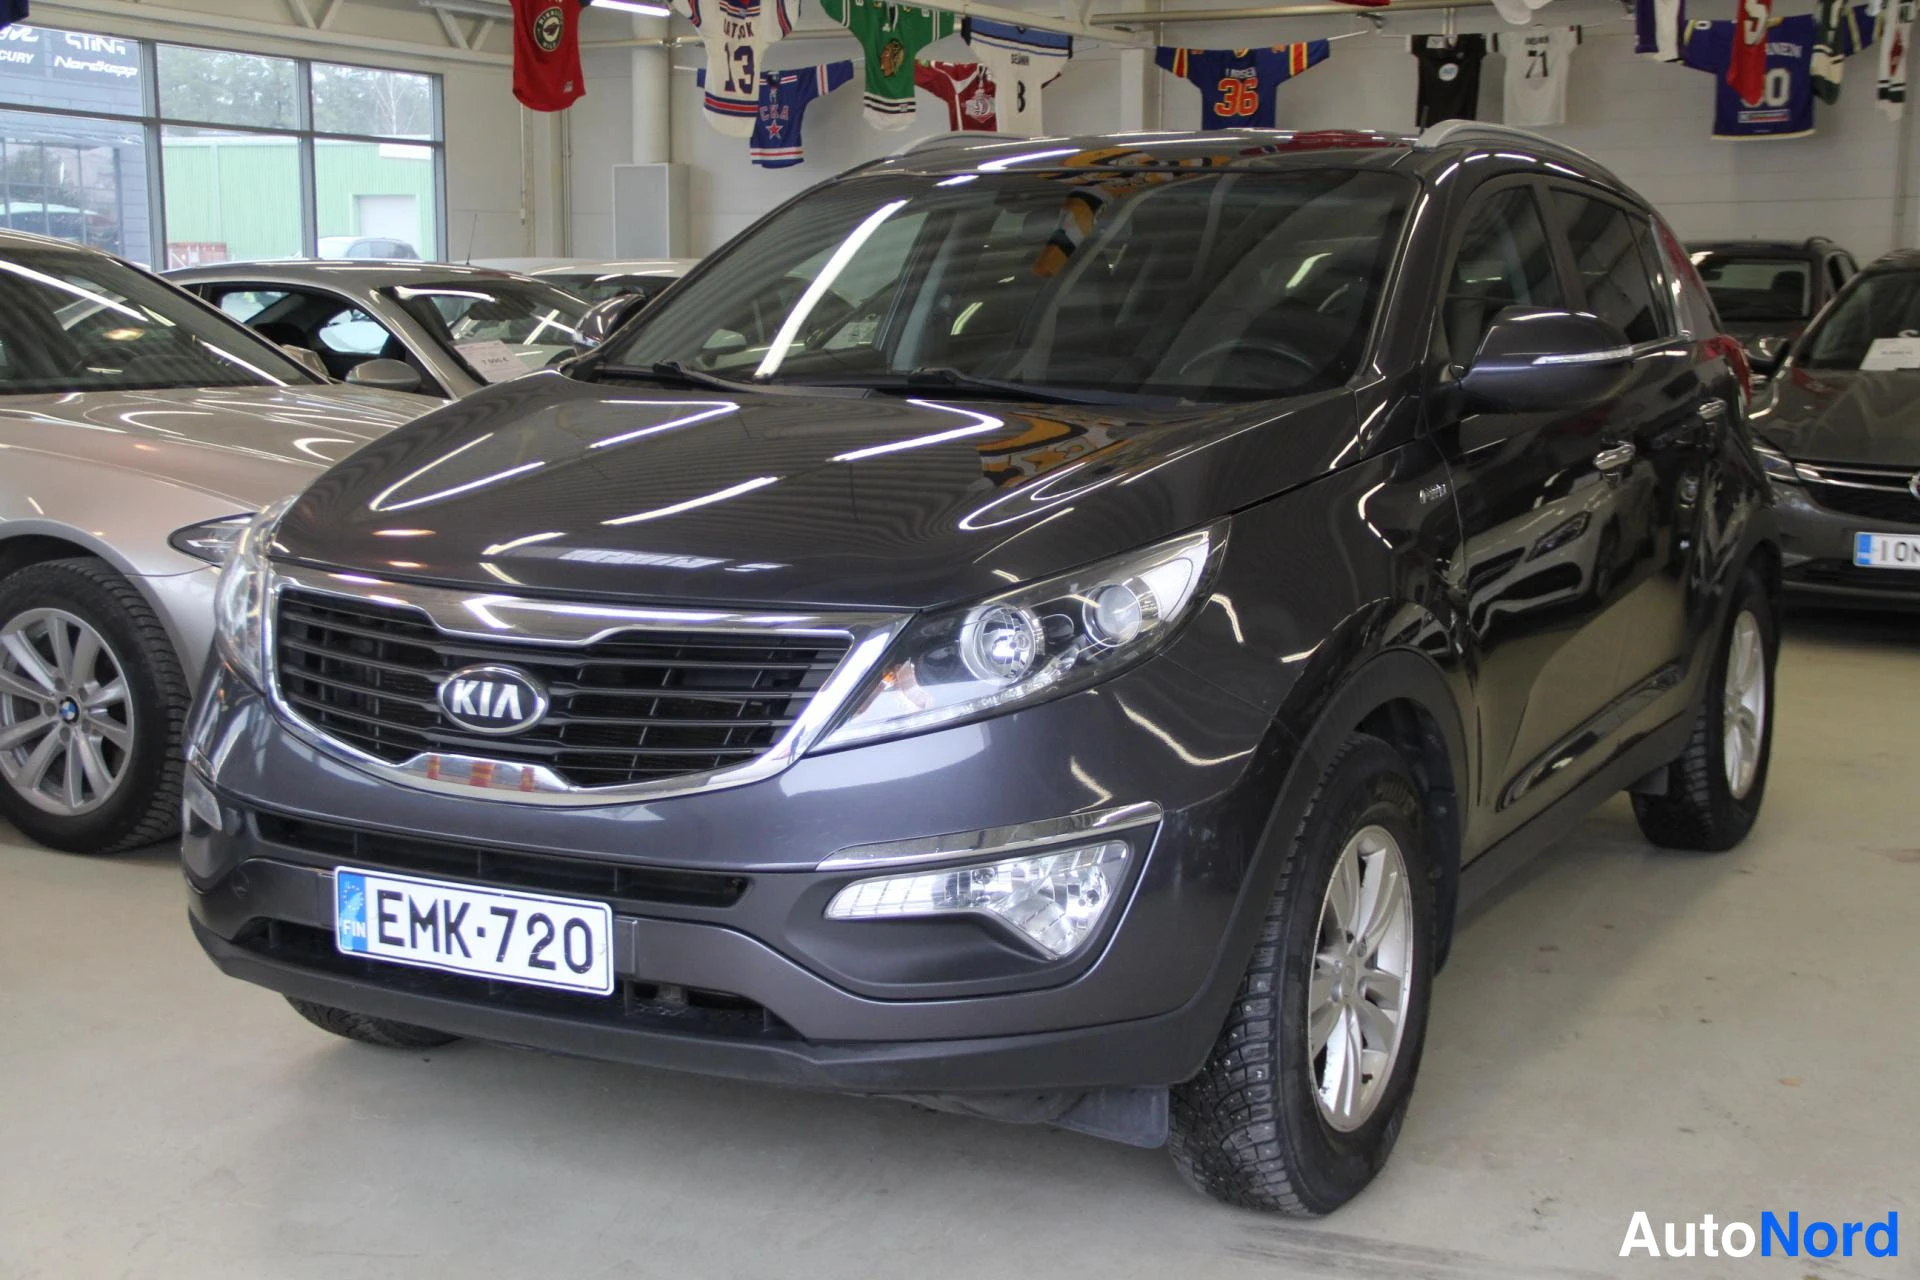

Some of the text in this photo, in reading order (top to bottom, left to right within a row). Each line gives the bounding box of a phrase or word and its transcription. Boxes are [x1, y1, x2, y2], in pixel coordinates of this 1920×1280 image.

[724, 41, 756, 95] 13
[1525, 50, 1549, 79] 71
[1213, 77, 1260, 117] 36
[451, 679, 524, 720] KIA
[343, 921, 366, 938] FIN
[376, 888, 594, 976] EMK-720
